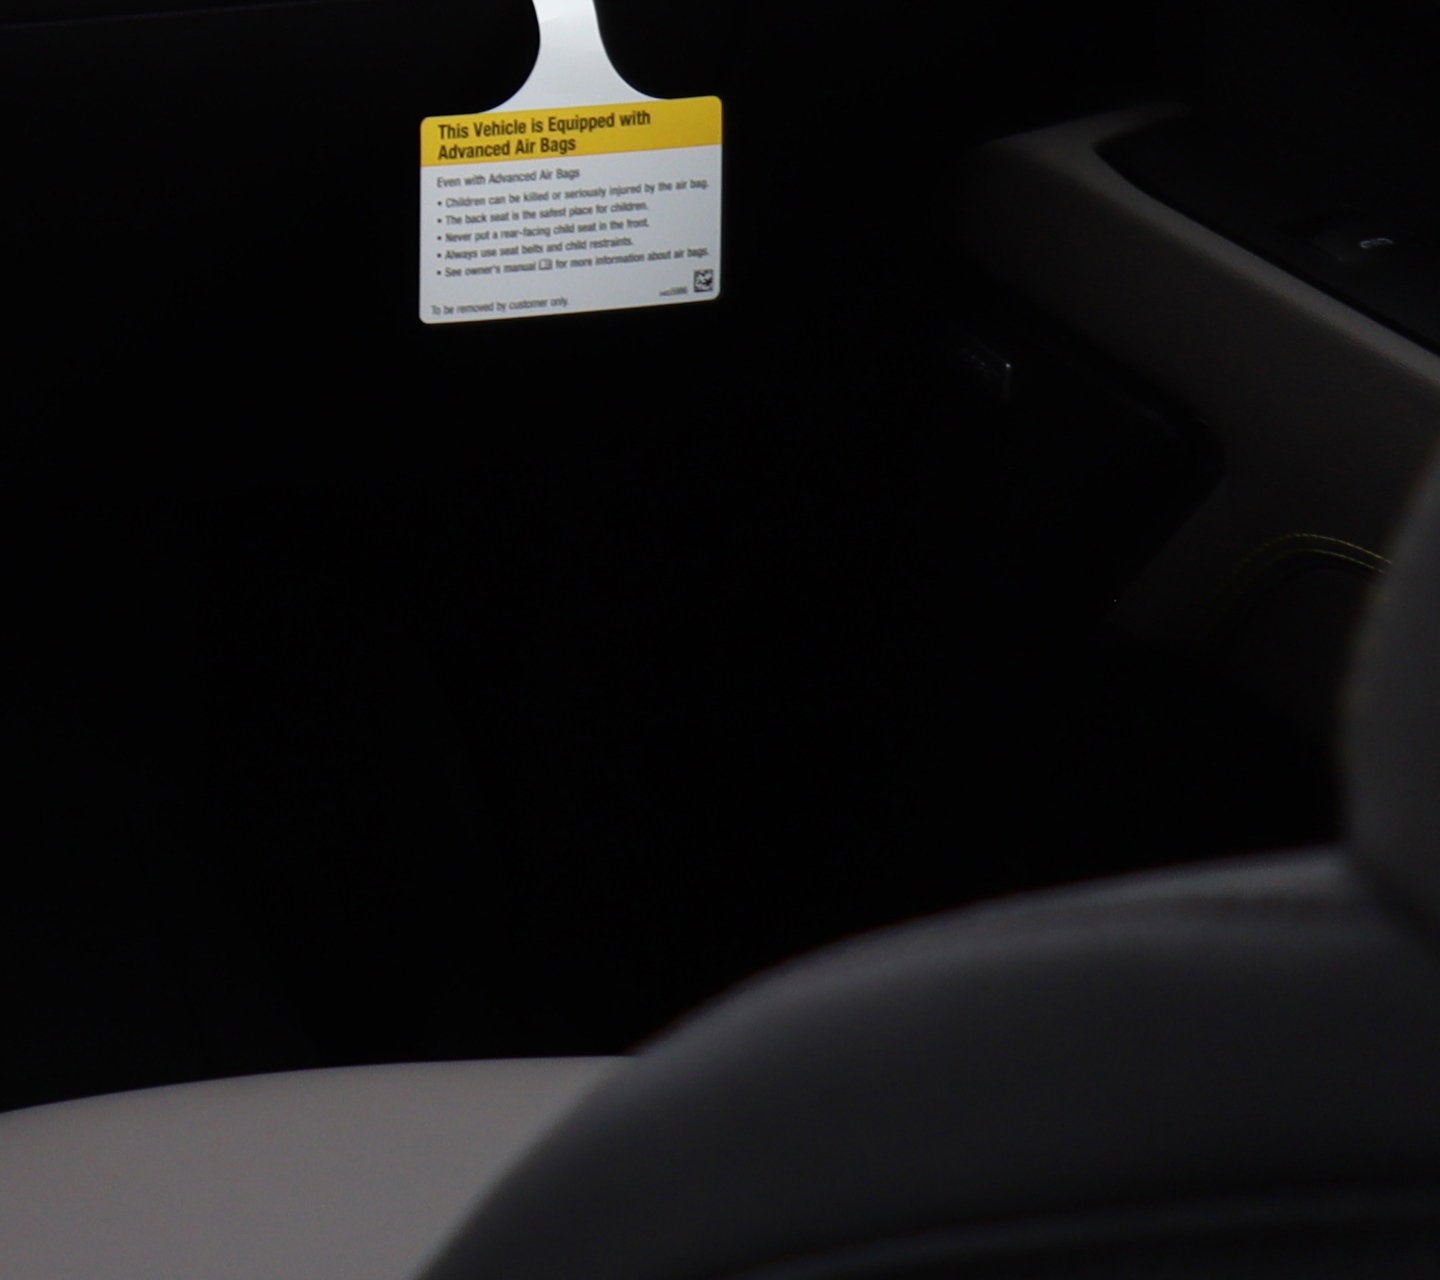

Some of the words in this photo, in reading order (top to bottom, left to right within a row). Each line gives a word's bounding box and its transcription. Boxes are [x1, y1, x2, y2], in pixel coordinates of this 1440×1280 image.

[438, 123, 469, 140] This
[473, 119, 526, 138] Vehicle
[531, 119, 544, 134] is
[548, 112, 615, 134] Equipped
[620, 110, 651, 126] with
[438, 140, 510, 160] Advanced
[515, 138, 536, 154] Air
[540, 137, 576, 155] Bags
[437, 176, 462, 188] Even
[464, 175, 485, 186] with
[488, 170, 538, 185] Advanced
[539, 169, 554, 181] Air
[556, 168, 580, 181] Bags
[445, 197, 486, 208] Children
[488, 196, 506, 205] can
[508, 193, 522, 204] be
[523, 191, 550, 202] killed
[552, 191, 562, 200] or
[564, 185, 607, 199] seriously
[609, 183, 642, 197] injured
[644, 182, 656, 194] by
[658, 181, 673, 191] the
[675, 180, 687, 190] air
[689, 178, 709, 191] bag.
[445, 214, 463, 225] The
[465, 213, 487, 224] back
[490, 212, 509, 222] seat
[522, 210, 537, 220] the
[539, 207, 567, 219] safest
[568, 206, 593, 218] place
[595, 204, 608, 214] for
[610, 202, 649, 213] children.
[445, 232, 472, 243] Never
[474, 230, 490, 243] put
[500, 226, 551, 239] rear-facing
[553, 223, 576, 234] child
[577, 222, 597, 233] seat
[609, 220, 624, 230] the
[626, 217, 650, 229] front.
[445, 249, 478, 261] Always
[480, 248, 497, 258] use
[499, 246, 519, 257] seat
[521, 243, 544, 255] belts
[546, 241, 563, 252] and
[565, 240, 588, 251] child
[589, 237, 634, 249] restraints.
[445, 267, 463, 278] See
[465, 264, 501, 276] owner's
[503, 262, 537, 273] manual
[555, 259, 568, 269] for
[570, 258, 593, 268] more
[595, 253, 645, 265] information
[647, 250, 672, 261] about
[673, 249, 685, 259] air
[687, 247, 710, 259] bags.
[430, 304, 441, 316] To
[443, 304, 454, 315] be
[456, 301, 494, 314] removed
[496, 301, 507, 313] by
[508, 297, 547, 311] customer
[550, 295, 569, 309] only.
